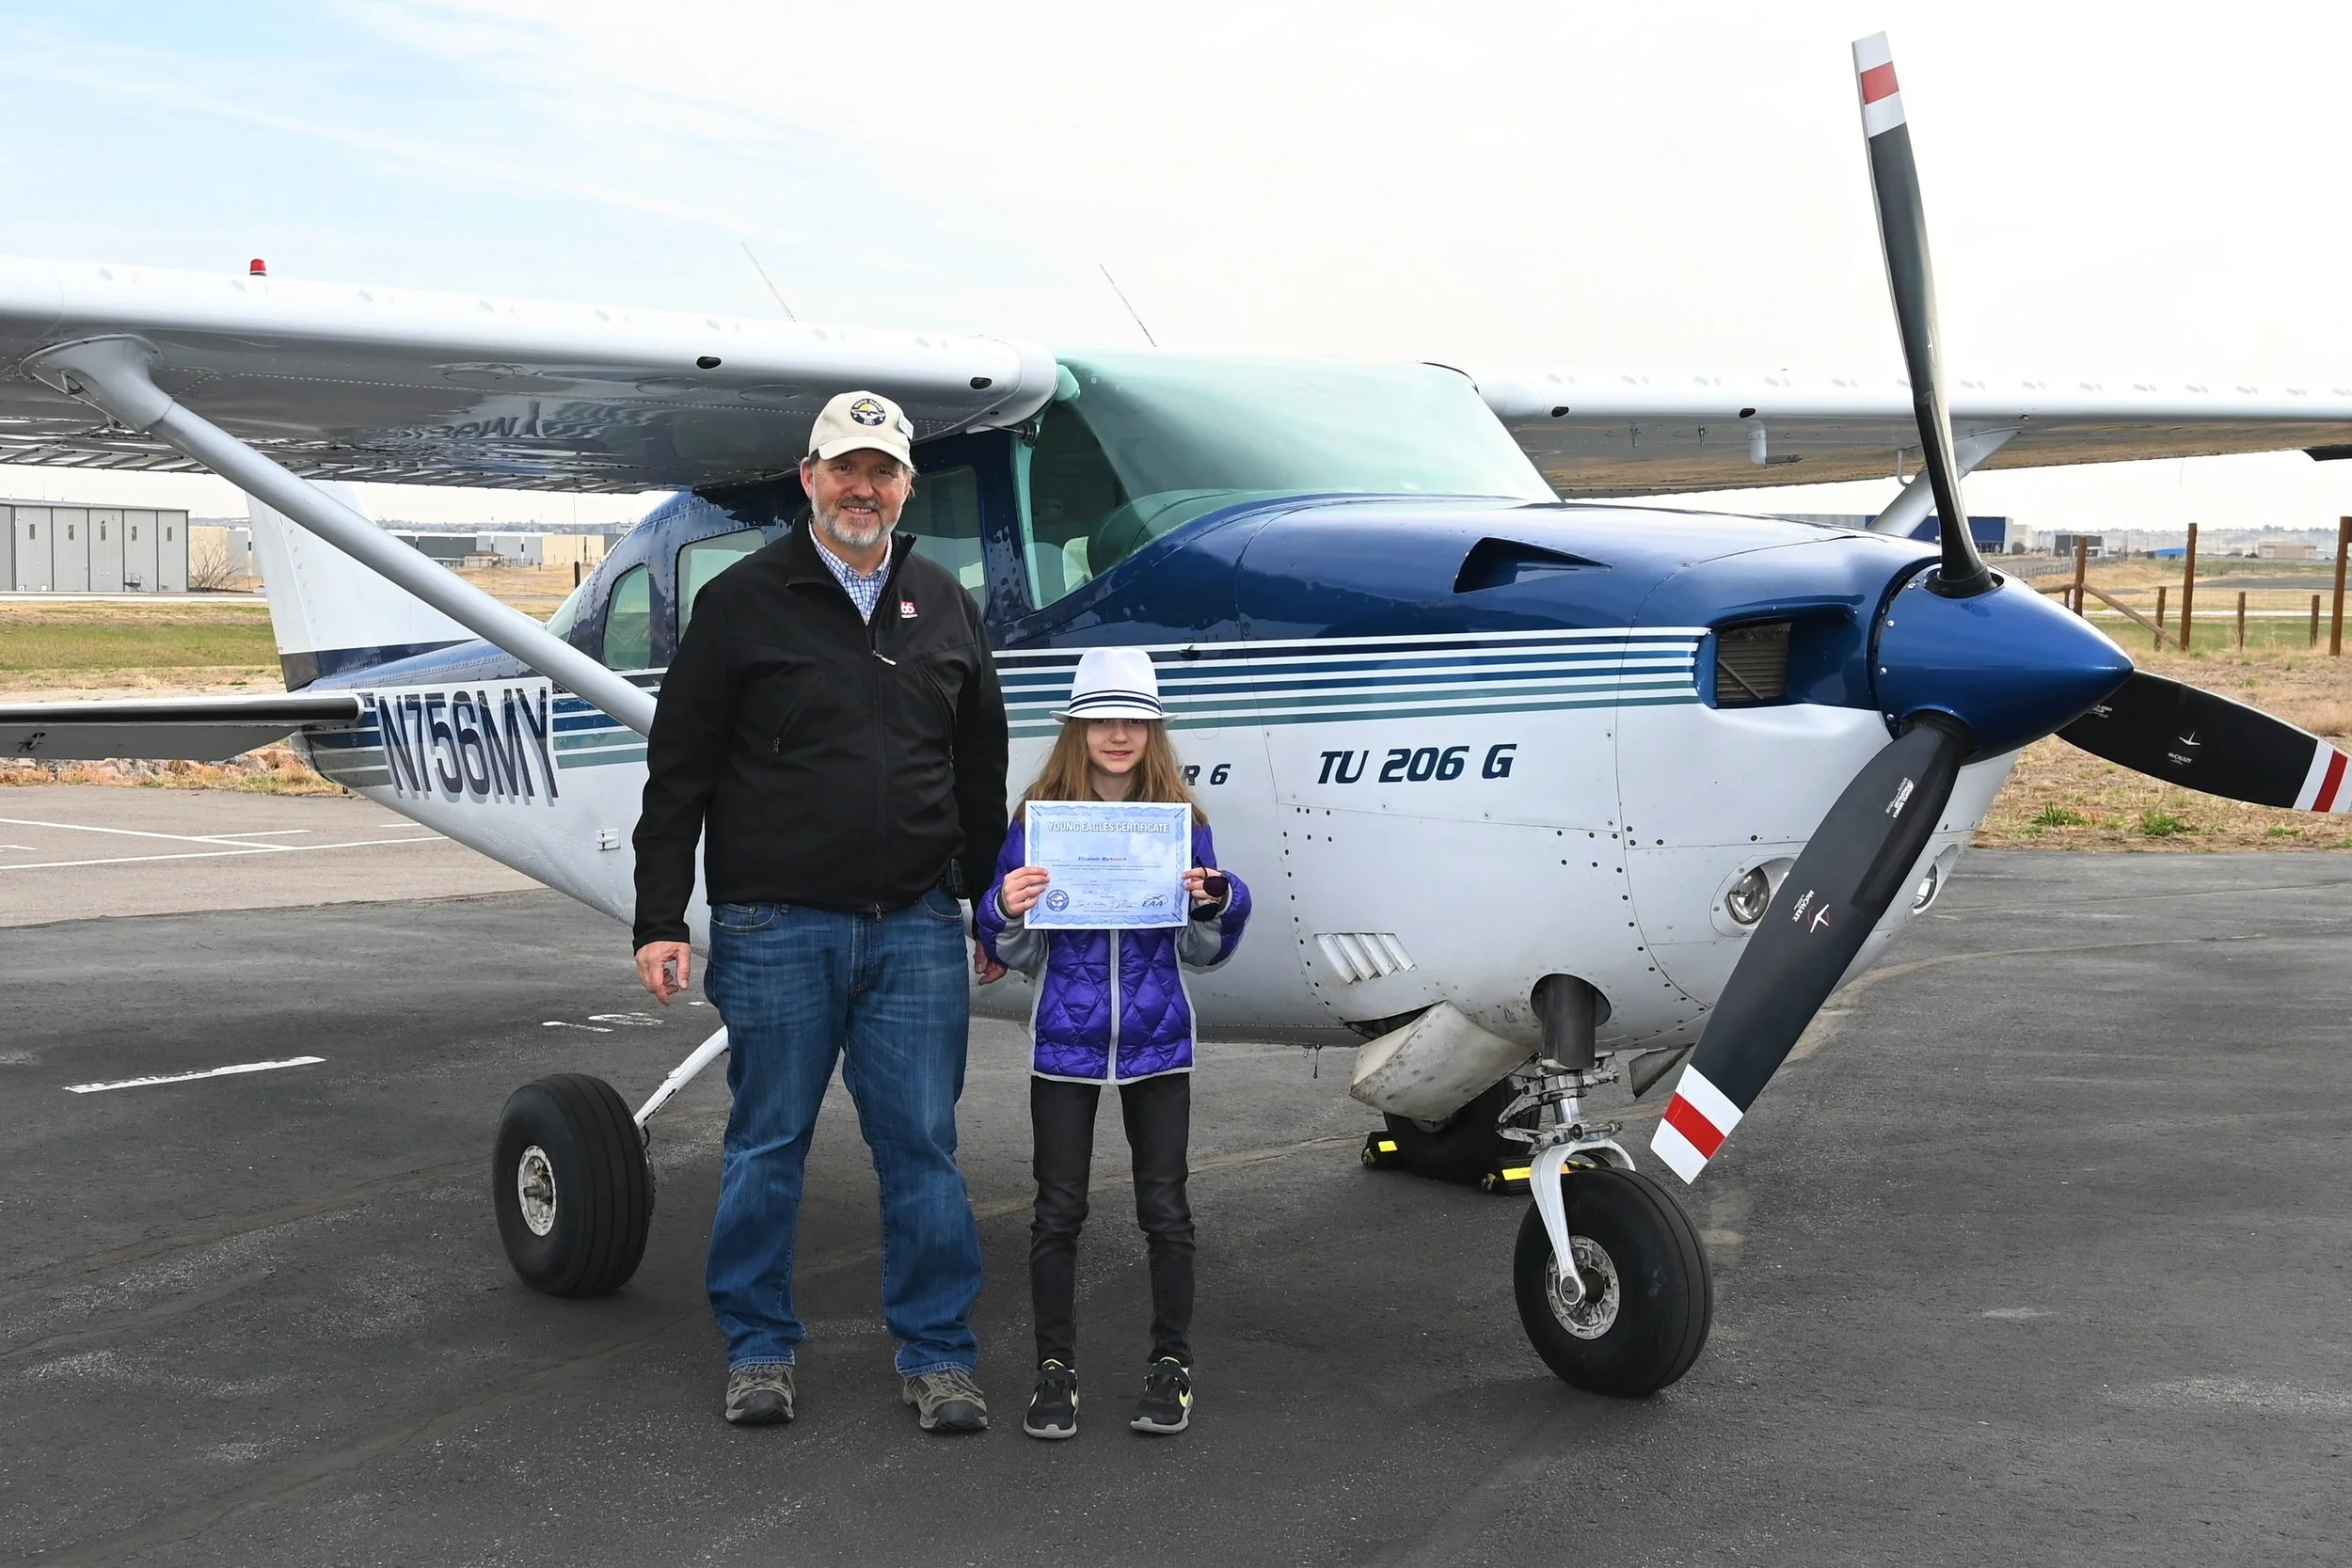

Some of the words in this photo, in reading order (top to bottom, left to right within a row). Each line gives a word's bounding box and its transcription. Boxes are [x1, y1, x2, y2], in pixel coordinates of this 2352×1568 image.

[378, 687, 559, 805] N756MY
[1177, 764, 1200, 786] R
[1210, 763, 1232, 785] 6
[1317, 750, 1370, 784] TU
[1378, 745, 1470, 784] 206
[1481, 743, 1518, 780] G
[1047, 821, 1080, 832] YOUNG
[1081, 821, 1115, 832] EAGLES
[1116, 822, 1169, 833] CERTIFICATE
